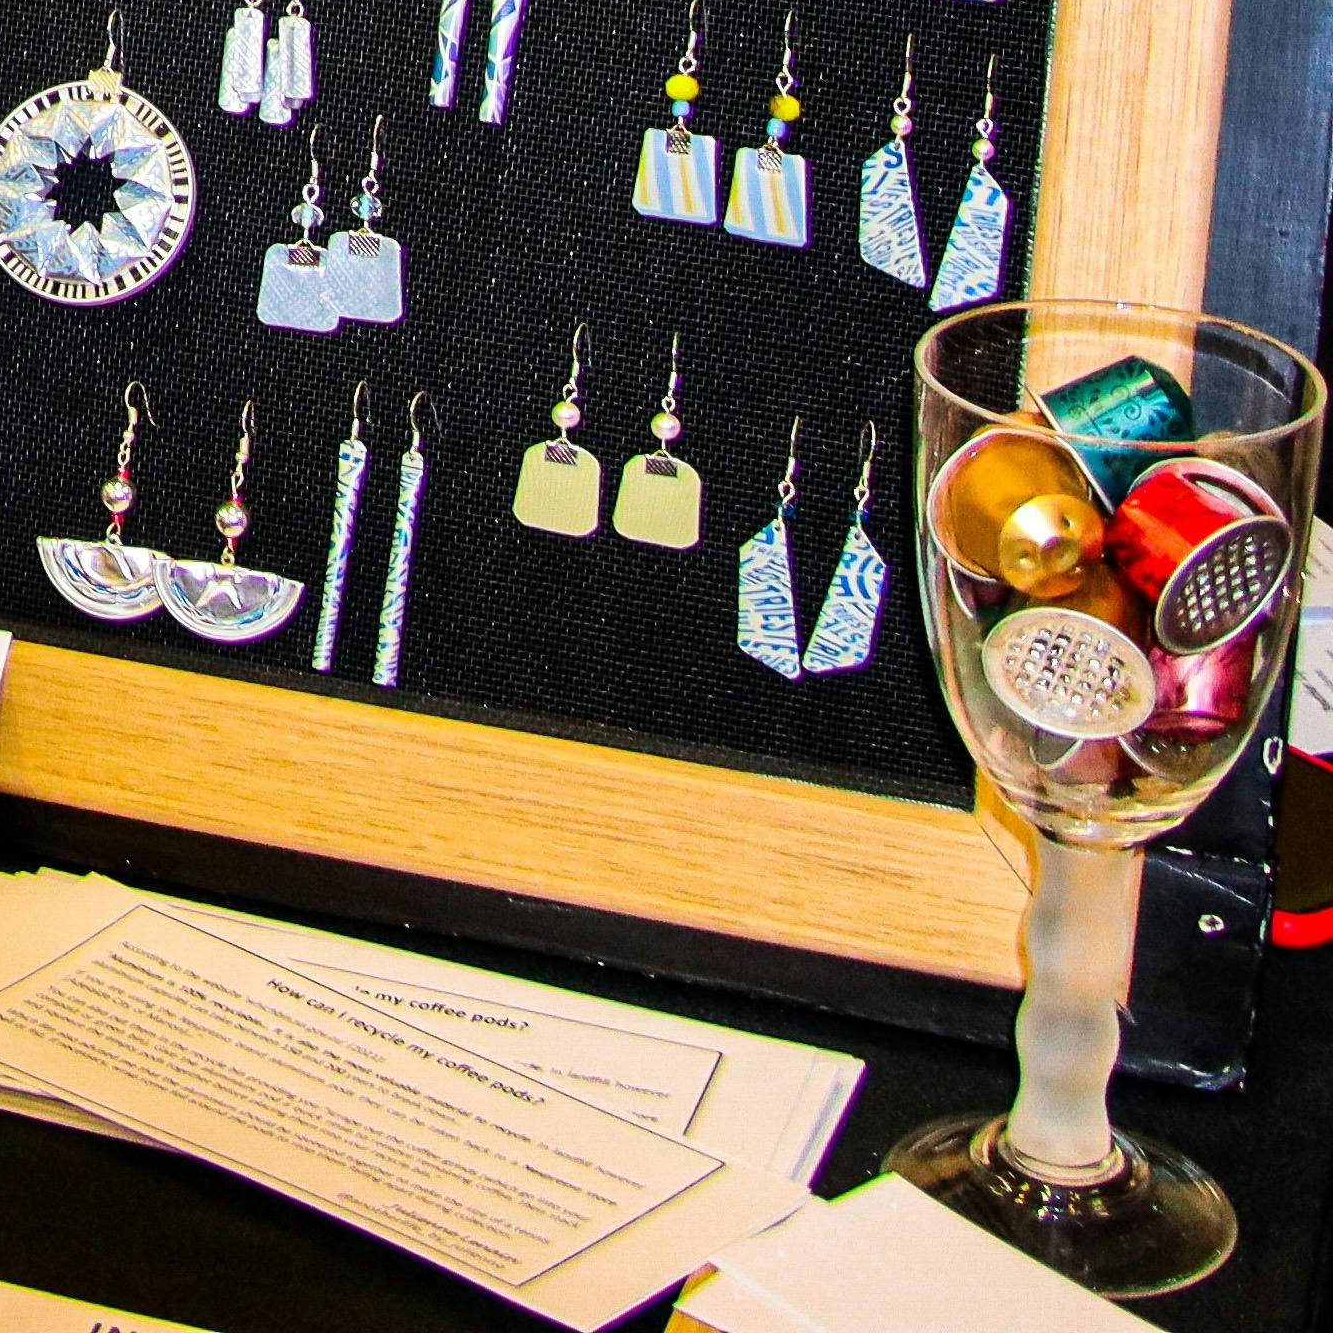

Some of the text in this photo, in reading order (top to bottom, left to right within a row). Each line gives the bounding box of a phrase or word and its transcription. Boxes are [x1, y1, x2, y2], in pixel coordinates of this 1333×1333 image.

[264, 979, 546, 1106] How can I recycle my coffee pods?
[375, 990, 404, 1008] my
[409, 999, 467, 1018] coffee
[471, 1011, 530, 1032] pods?
